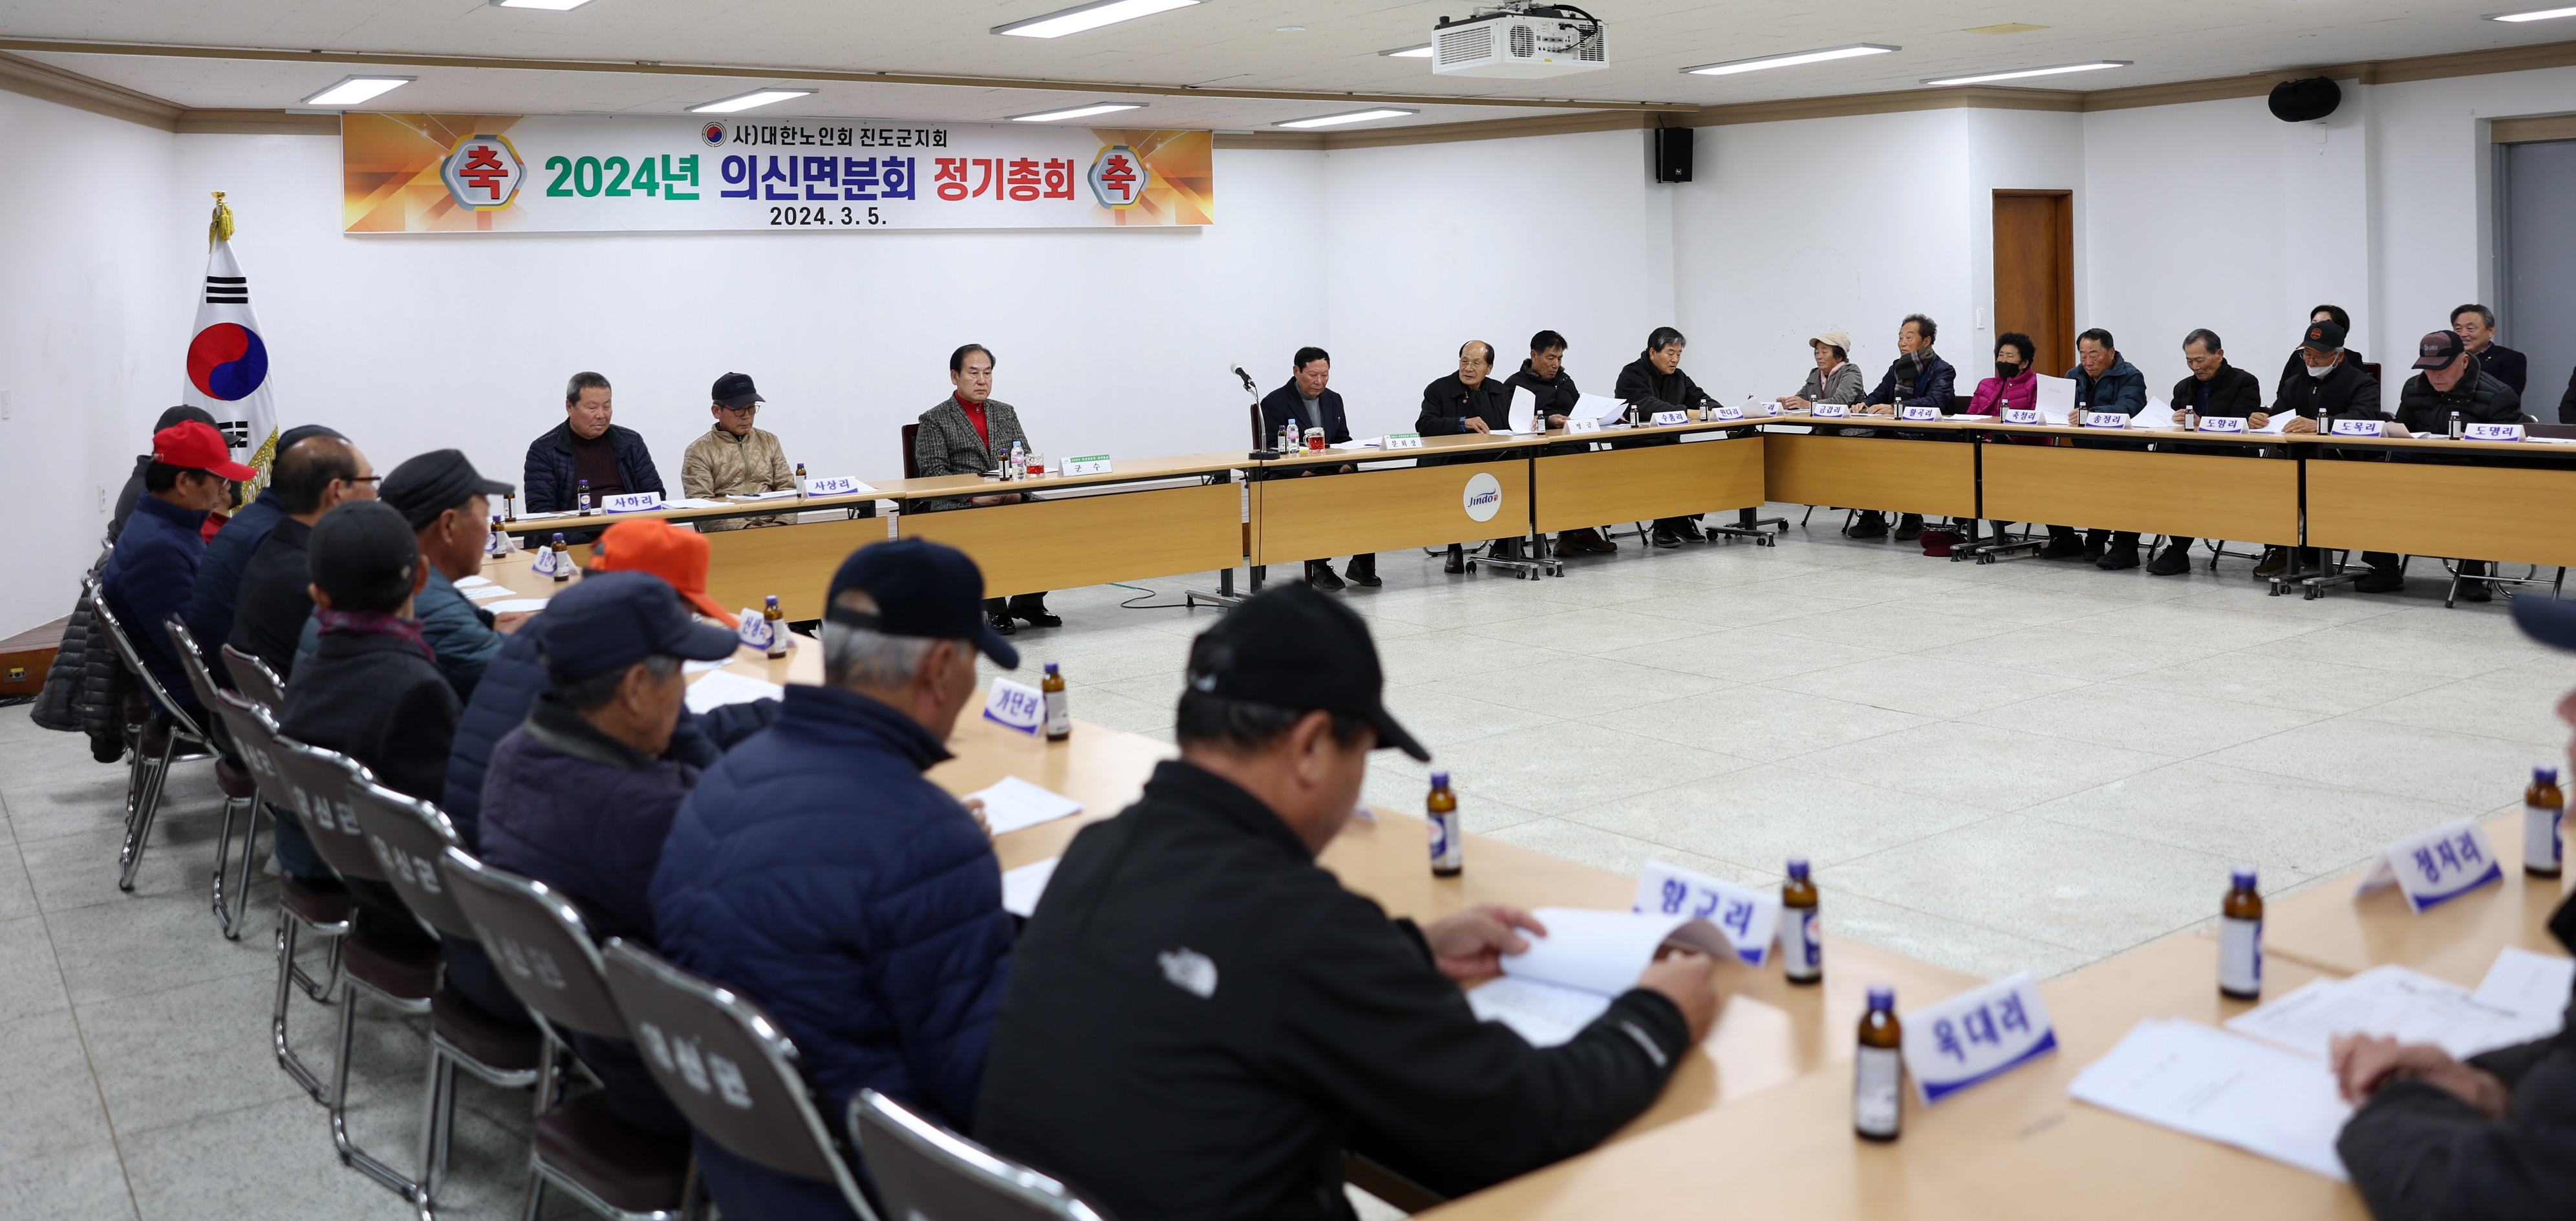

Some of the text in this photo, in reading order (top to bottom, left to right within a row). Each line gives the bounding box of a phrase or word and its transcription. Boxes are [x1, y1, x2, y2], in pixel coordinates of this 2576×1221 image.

[733, 125, 947, 147] 사)대한노인회 진도군지회
[460, 146, 508, 200] 축
[545, 154, 1075, 201] 2024년 의신면분회 정기총회
[1102, 155, 1136, 200] 축
[1819, 405, 1841, 414] 금갑리
[2012, 411, 2036, 420] 죽청리
[1662, 413, 1683, 422] 수품리
[2094, 415, 2121, 424] 송정리
[2207, 419, 2237, 429] 도항리
[2341, 422, 2376, 432] 도목리
[2475, 426, 2513, 436] 도명리
[815, 479, 850, 491] 사상리
[615, 495, 653, 507] 사하리
[1468, 495, 1493, 507] Jindo
[2412, 830, 2482, 884] 정지리
[1933, 990, 2030, 1063] 옥대리
